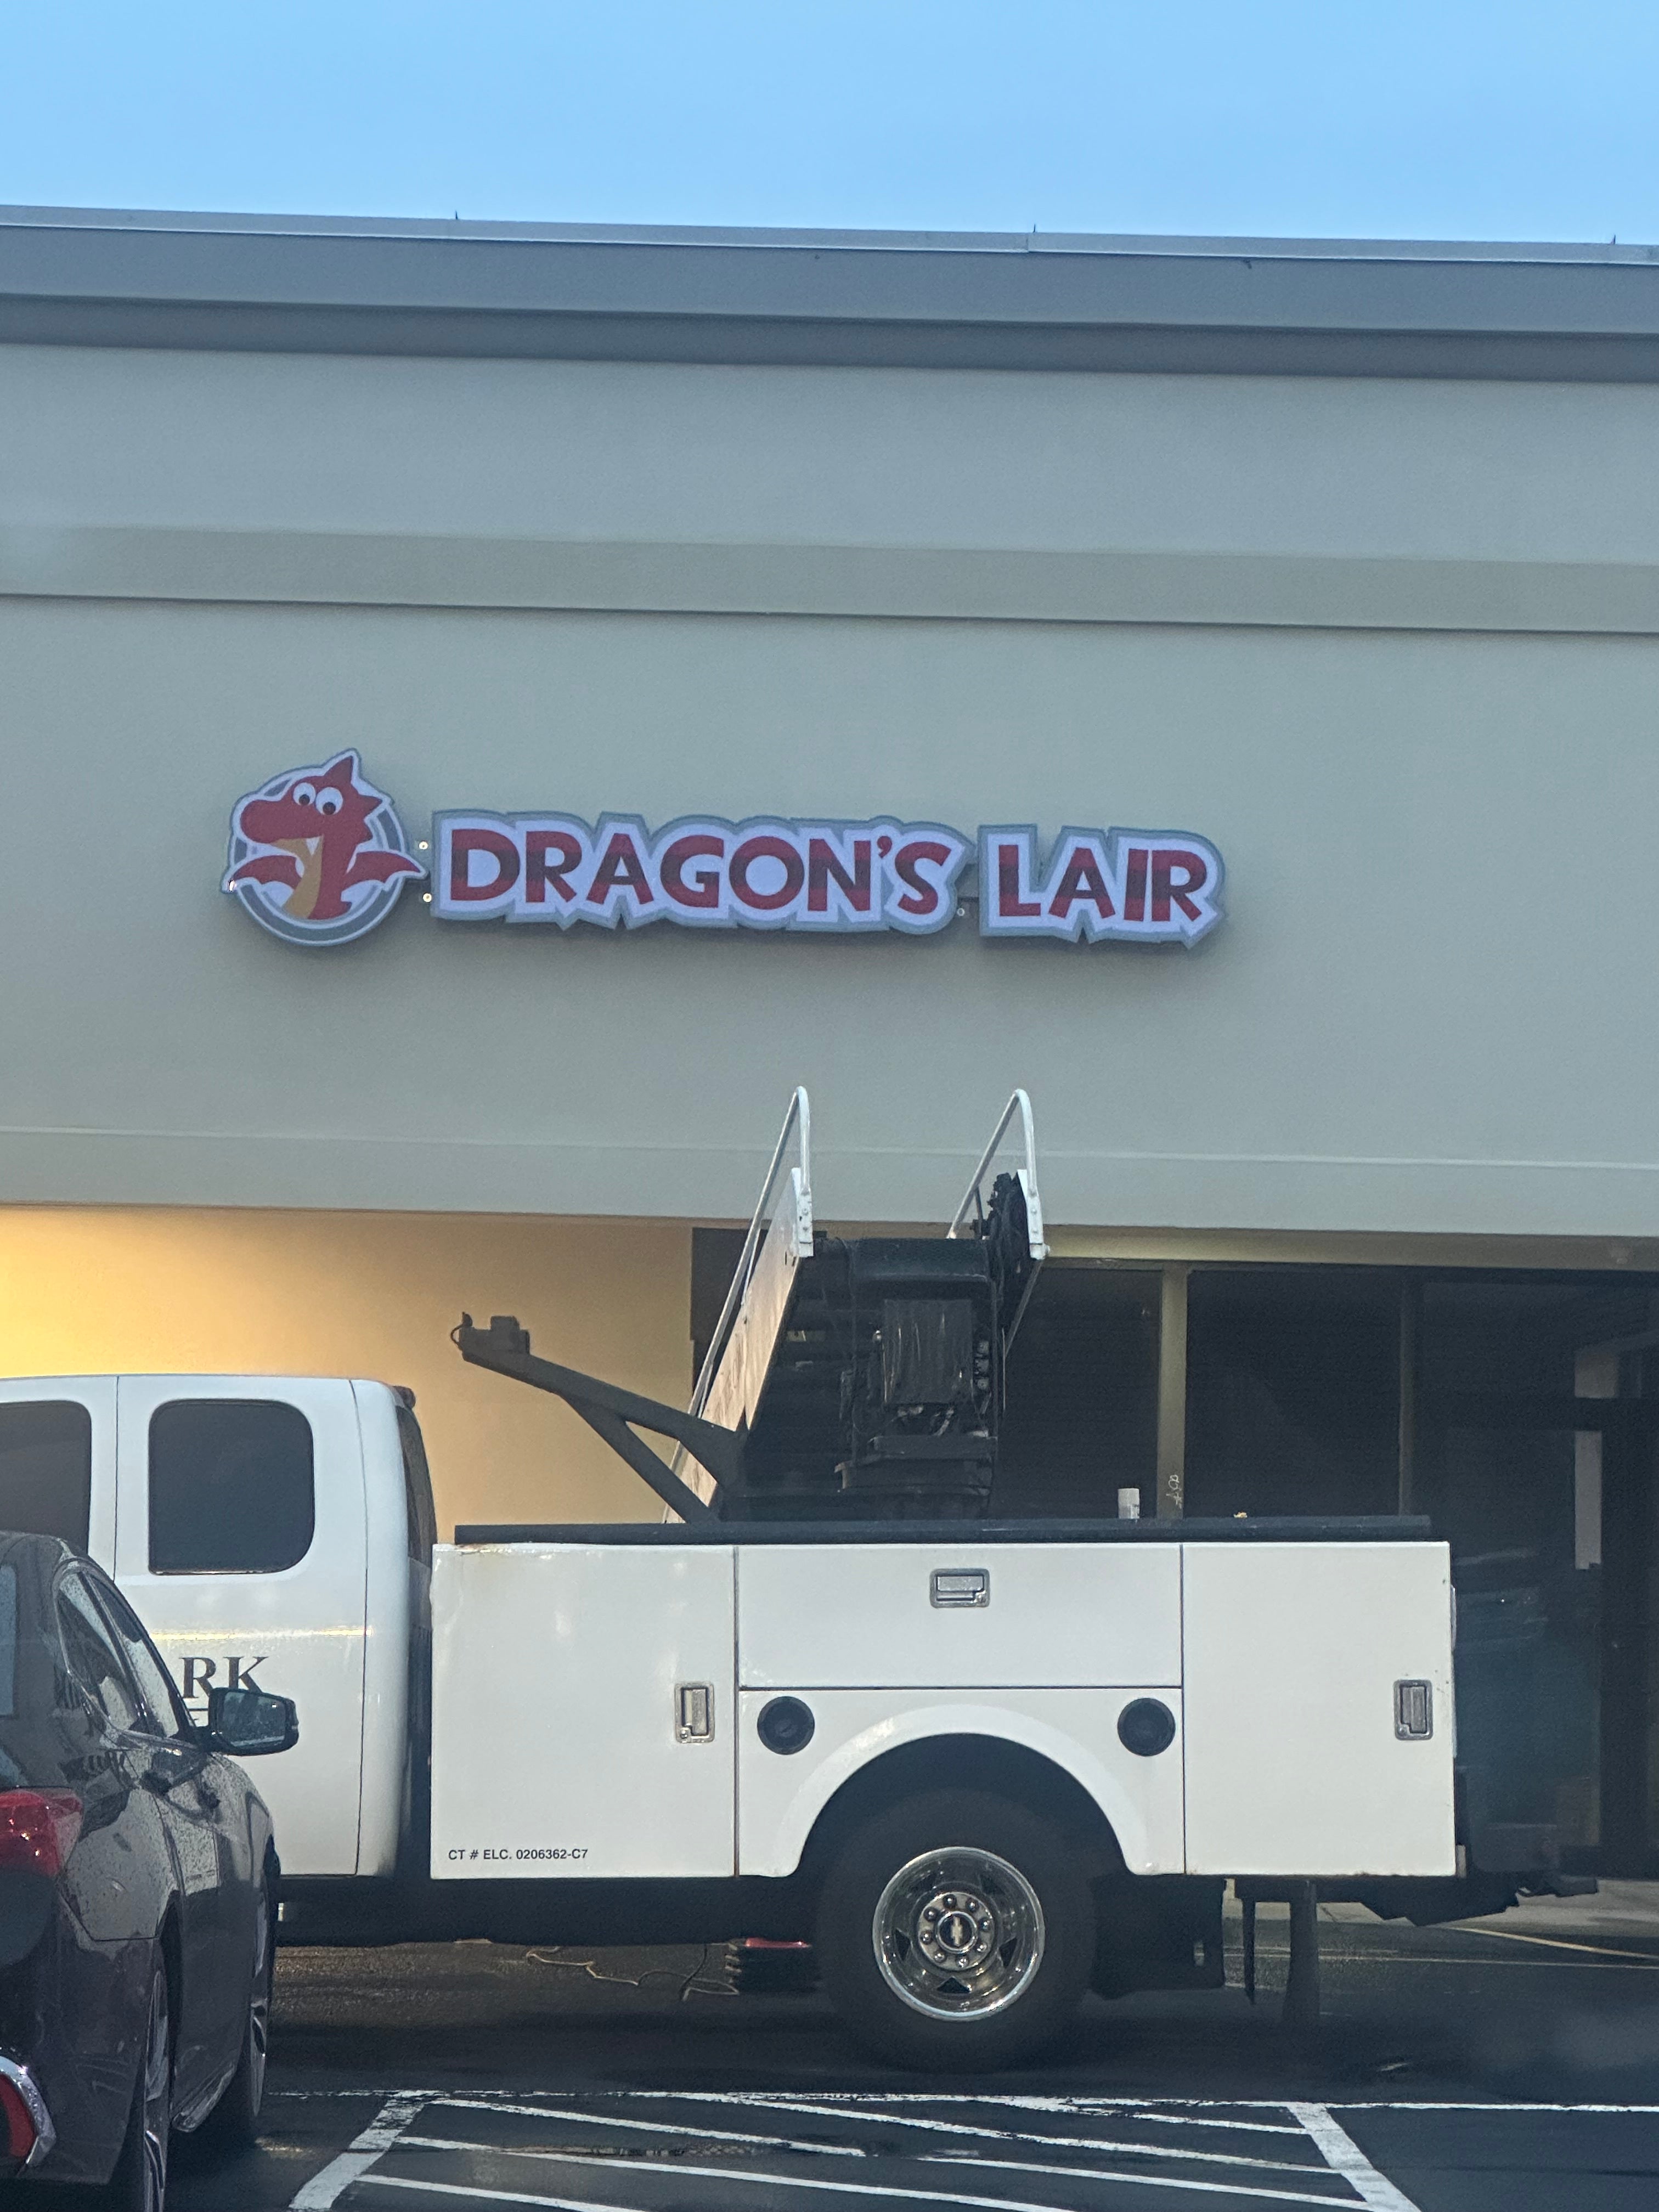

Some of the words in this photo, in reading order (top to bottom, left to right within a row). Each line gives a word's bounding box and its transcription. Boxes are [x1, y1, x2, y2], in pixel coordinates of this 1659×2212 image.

[450, 827, 952, 916] DRAGON'S
[997, 844, 1208, 923] LAIR
[448, 1849, 466, 1860] CT
[470, 1849, 479, 1860] #
[483, 1849, 512, 1859] ELC.
[516, 1848, 588, 1859] 0206362-C7
